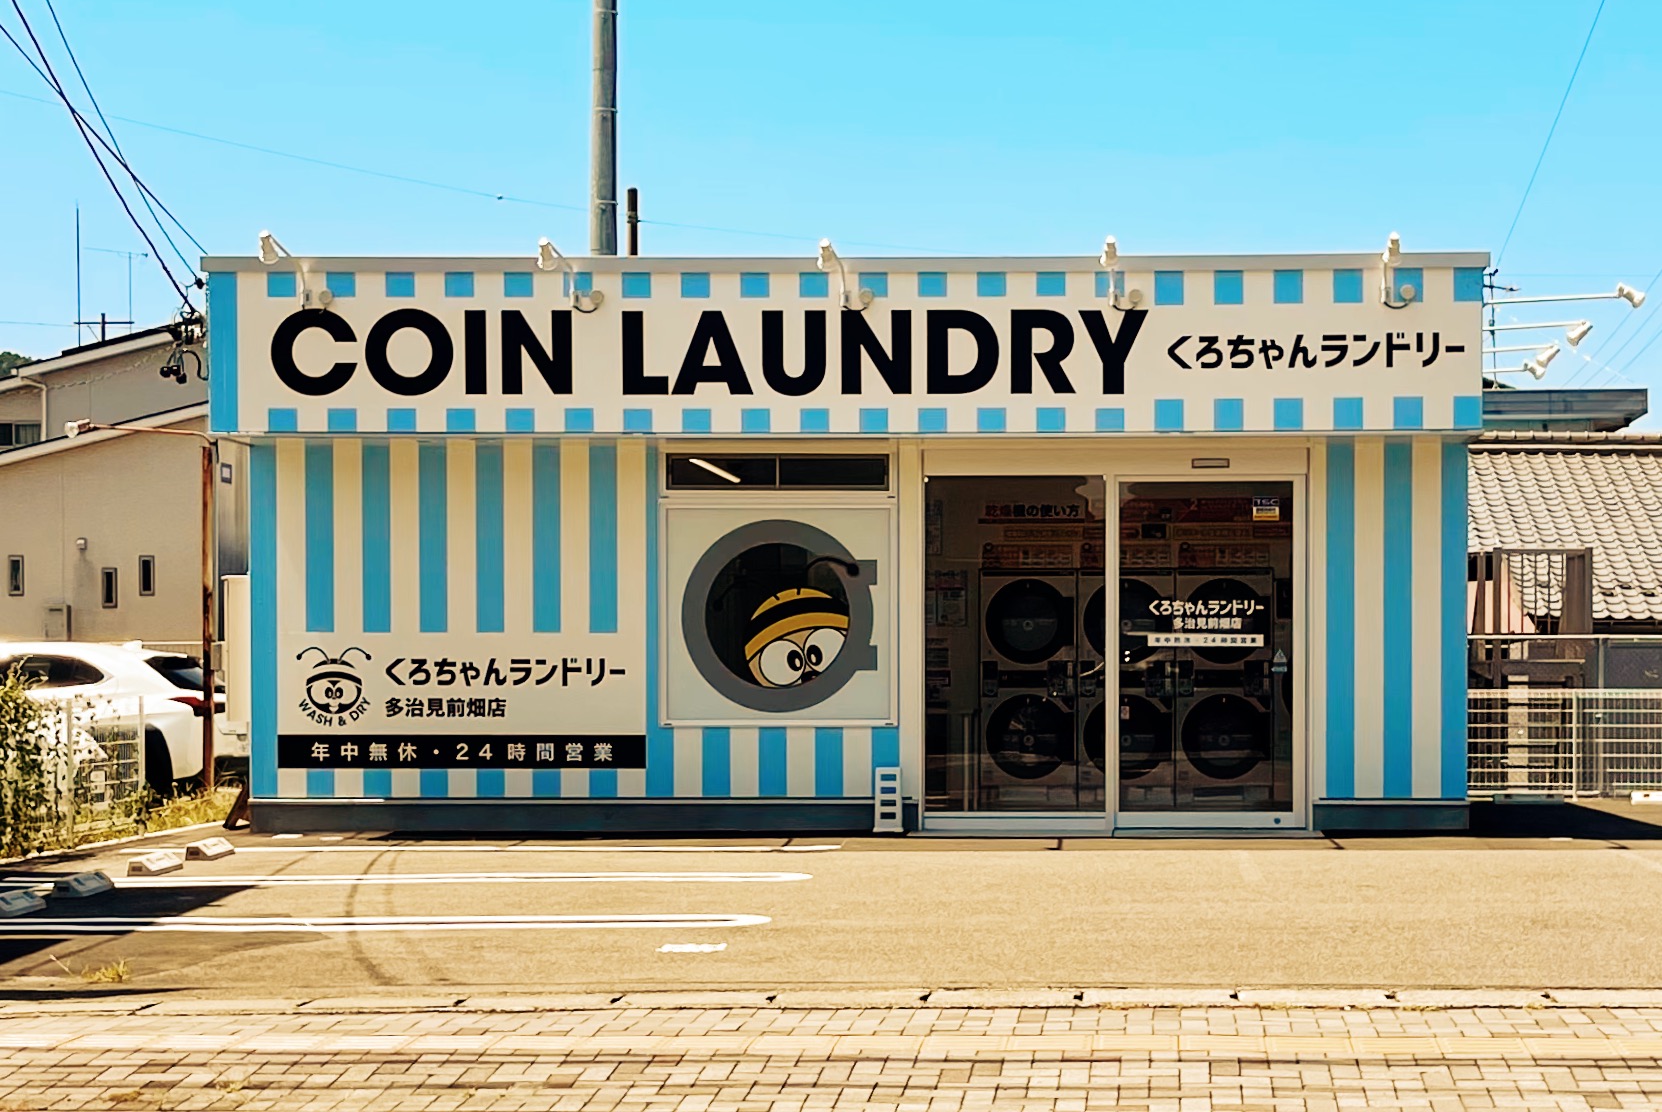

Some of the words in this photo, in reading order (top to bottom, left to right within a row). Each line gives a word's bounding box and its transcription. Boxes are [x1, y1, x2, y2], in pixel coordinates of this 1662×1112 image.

[271, 308, 573, 396] COIN
[622, 308, 1149, 396] LAUNDRY
[1168, 333, 1465, 370] くろちゃんランドリー
[1148, 599, 1265, 616] くろちゃんランドリー
[1173, 617, 1243, 630] 多治見前畑店
[386, 657, 626, 687] くろちゃんランドリー
[299, 698, 333, 727] WASH
[338, 716, 347, 727] &
[349, 697, 371, 722] DRY
[385, 697, 507, 718] 多治見前畑店
